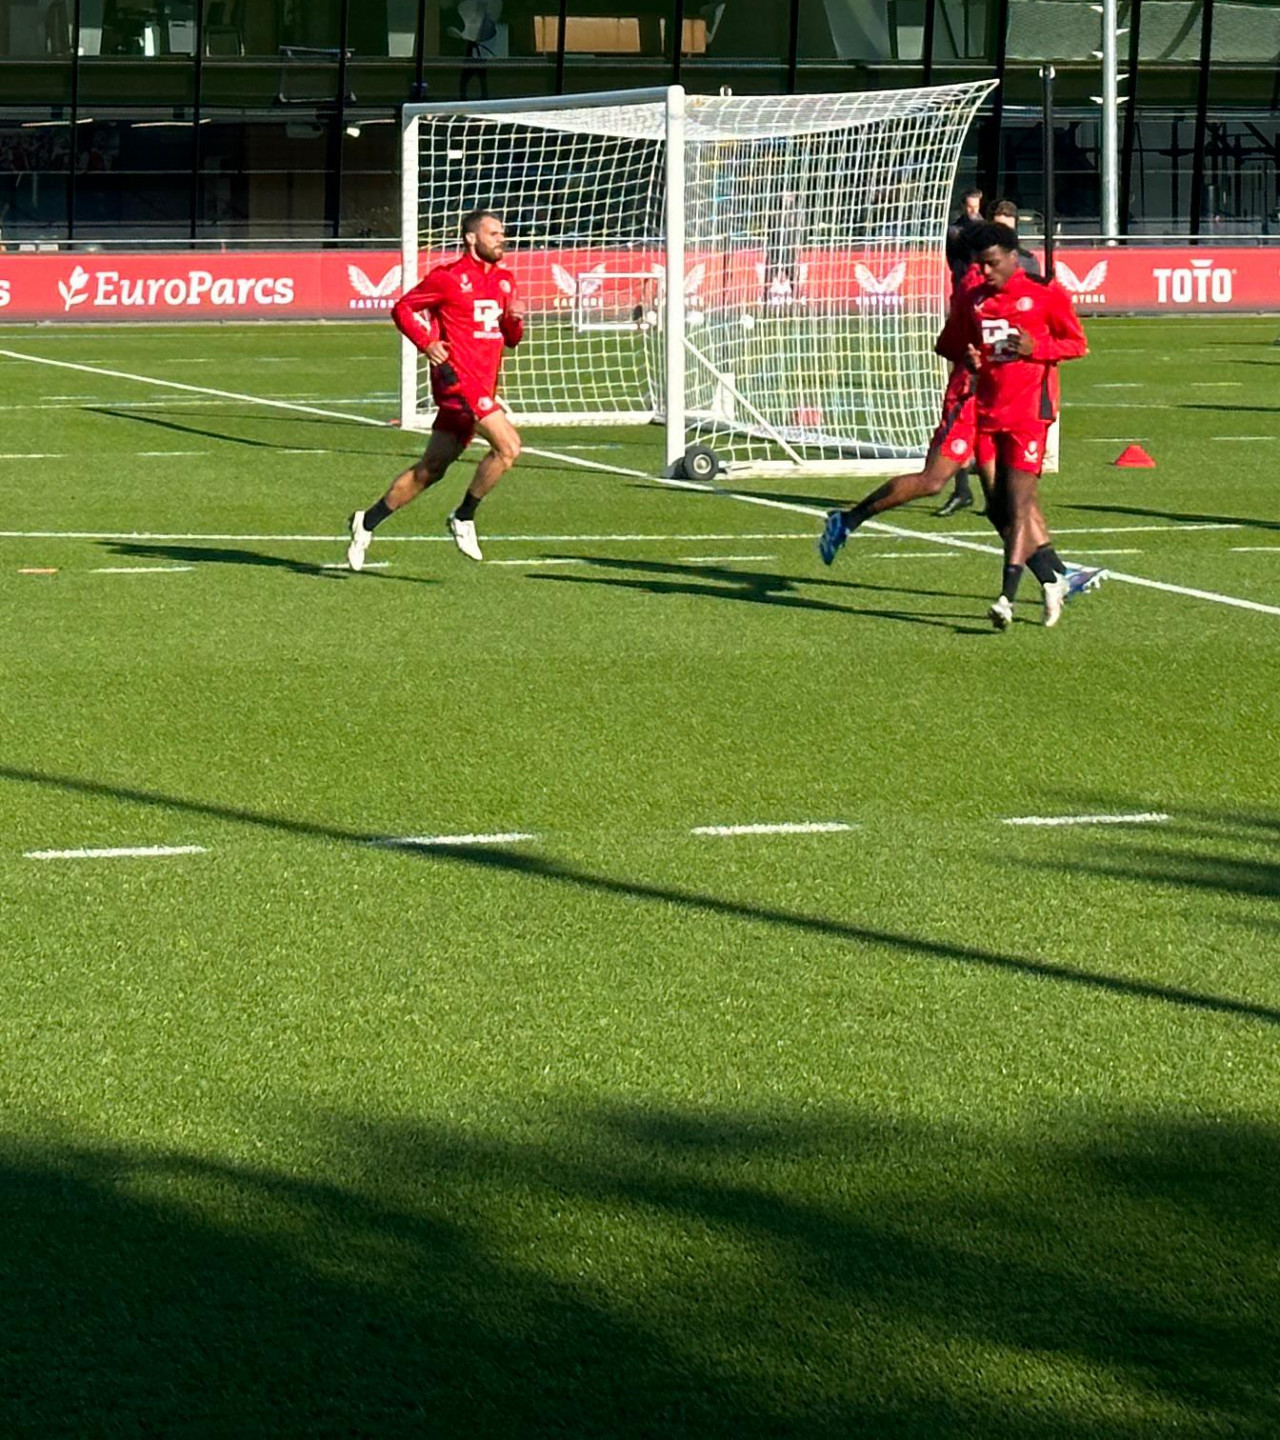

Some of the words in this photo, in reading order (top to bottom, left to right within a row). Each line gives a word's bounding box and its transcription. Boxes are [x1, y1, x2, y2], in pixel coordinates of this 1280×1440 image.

[93, 271, 294, 306] EuroParcs
[1152, 267, 1233, 303] TOTO
[349, 299, 399, 309] CASTOR
[1071, 294, 1106, 304] STORE
